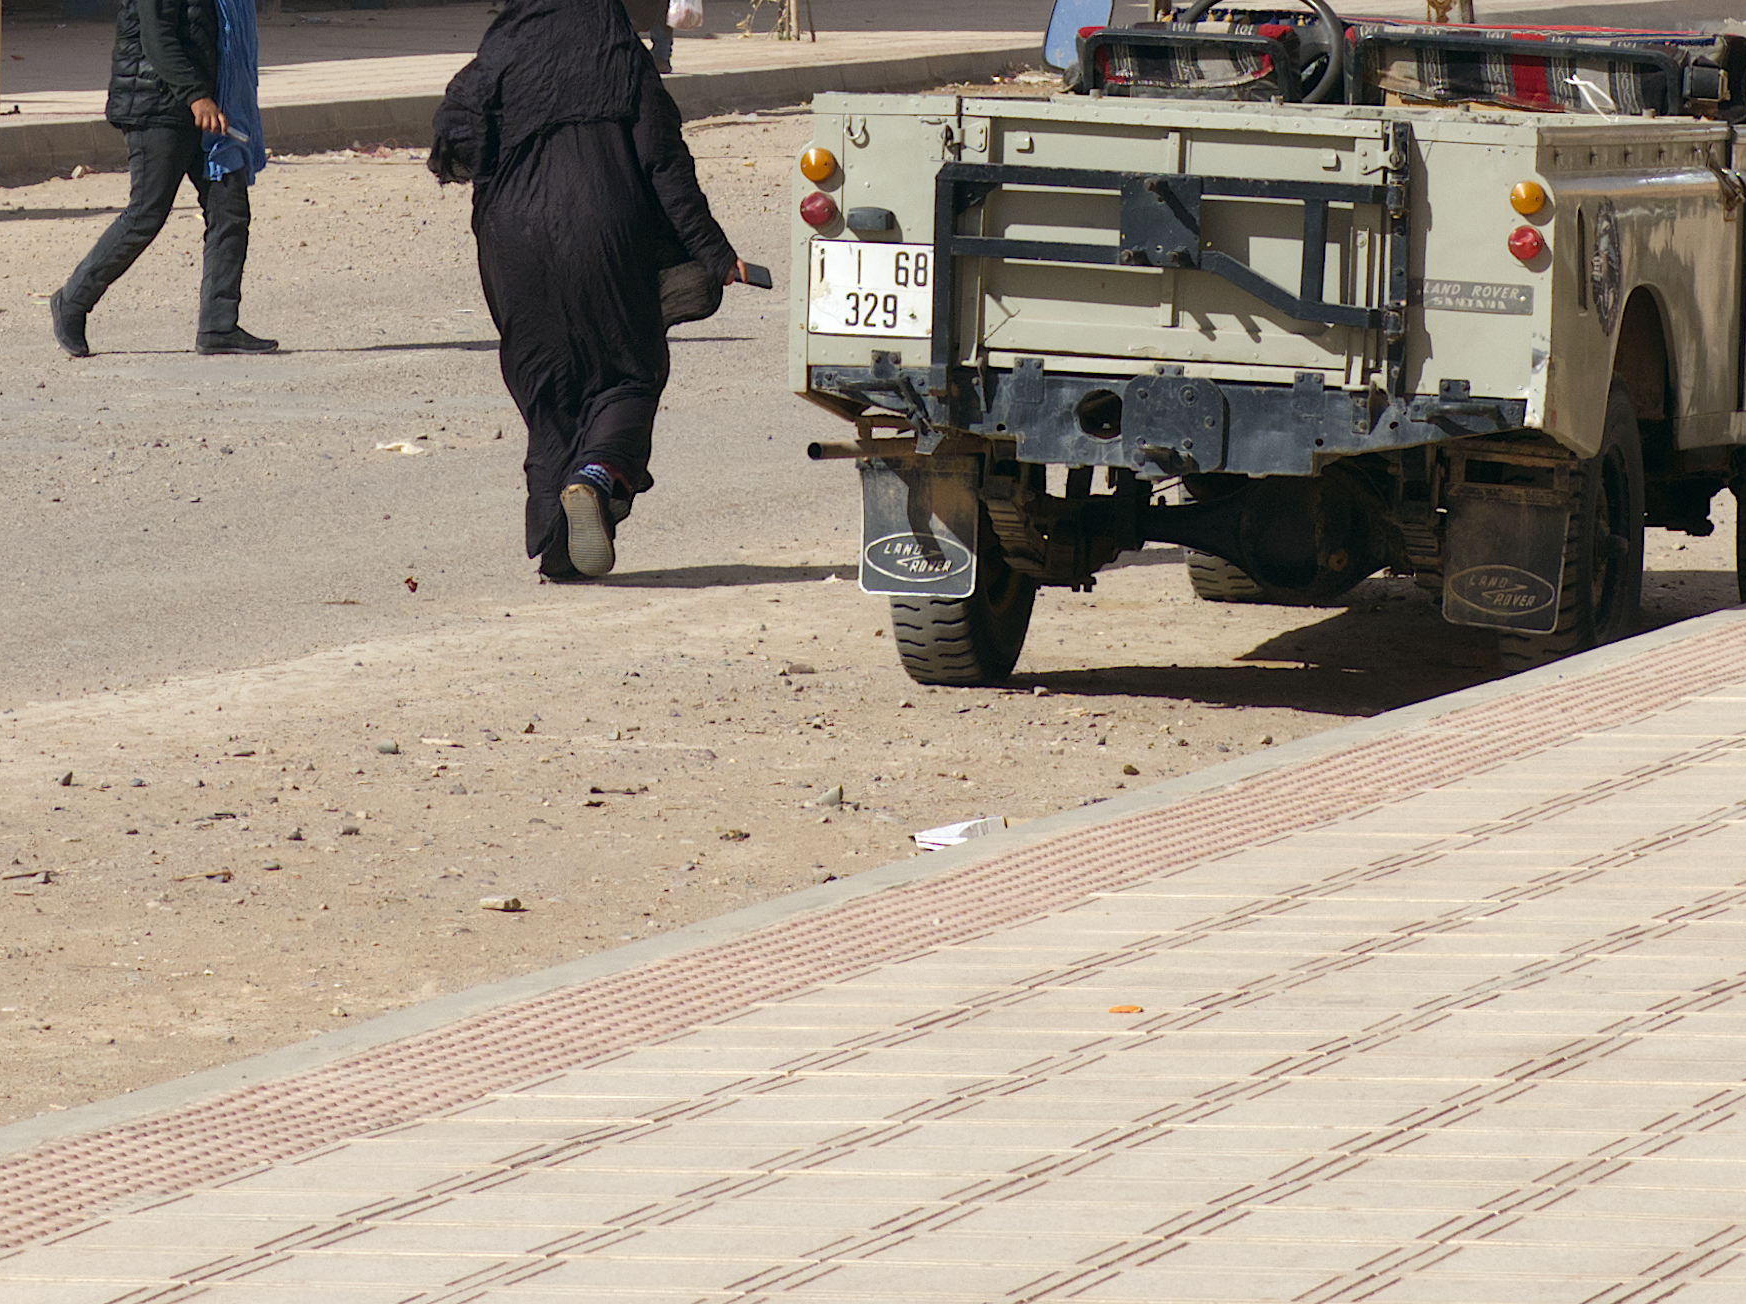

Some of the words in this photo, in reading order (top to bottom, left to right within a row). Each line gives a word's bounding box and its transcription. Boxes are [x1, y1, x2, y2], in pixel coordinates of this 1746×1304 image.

[894, 250, 928, 288] 68
[1423, 281, 1462, 296] LAND
[1471, 284, 1520, 300] ROVER
[844, 291, 899, 330] 329
[1433, 295, 1507, 311] SANTANA
[883, 541, 924, 556] LAND
[908, 559, 953, 574] ROVER
[1468, 573, 1509, 589] LAND
[1493, 592, 1537, 608] ROVER
